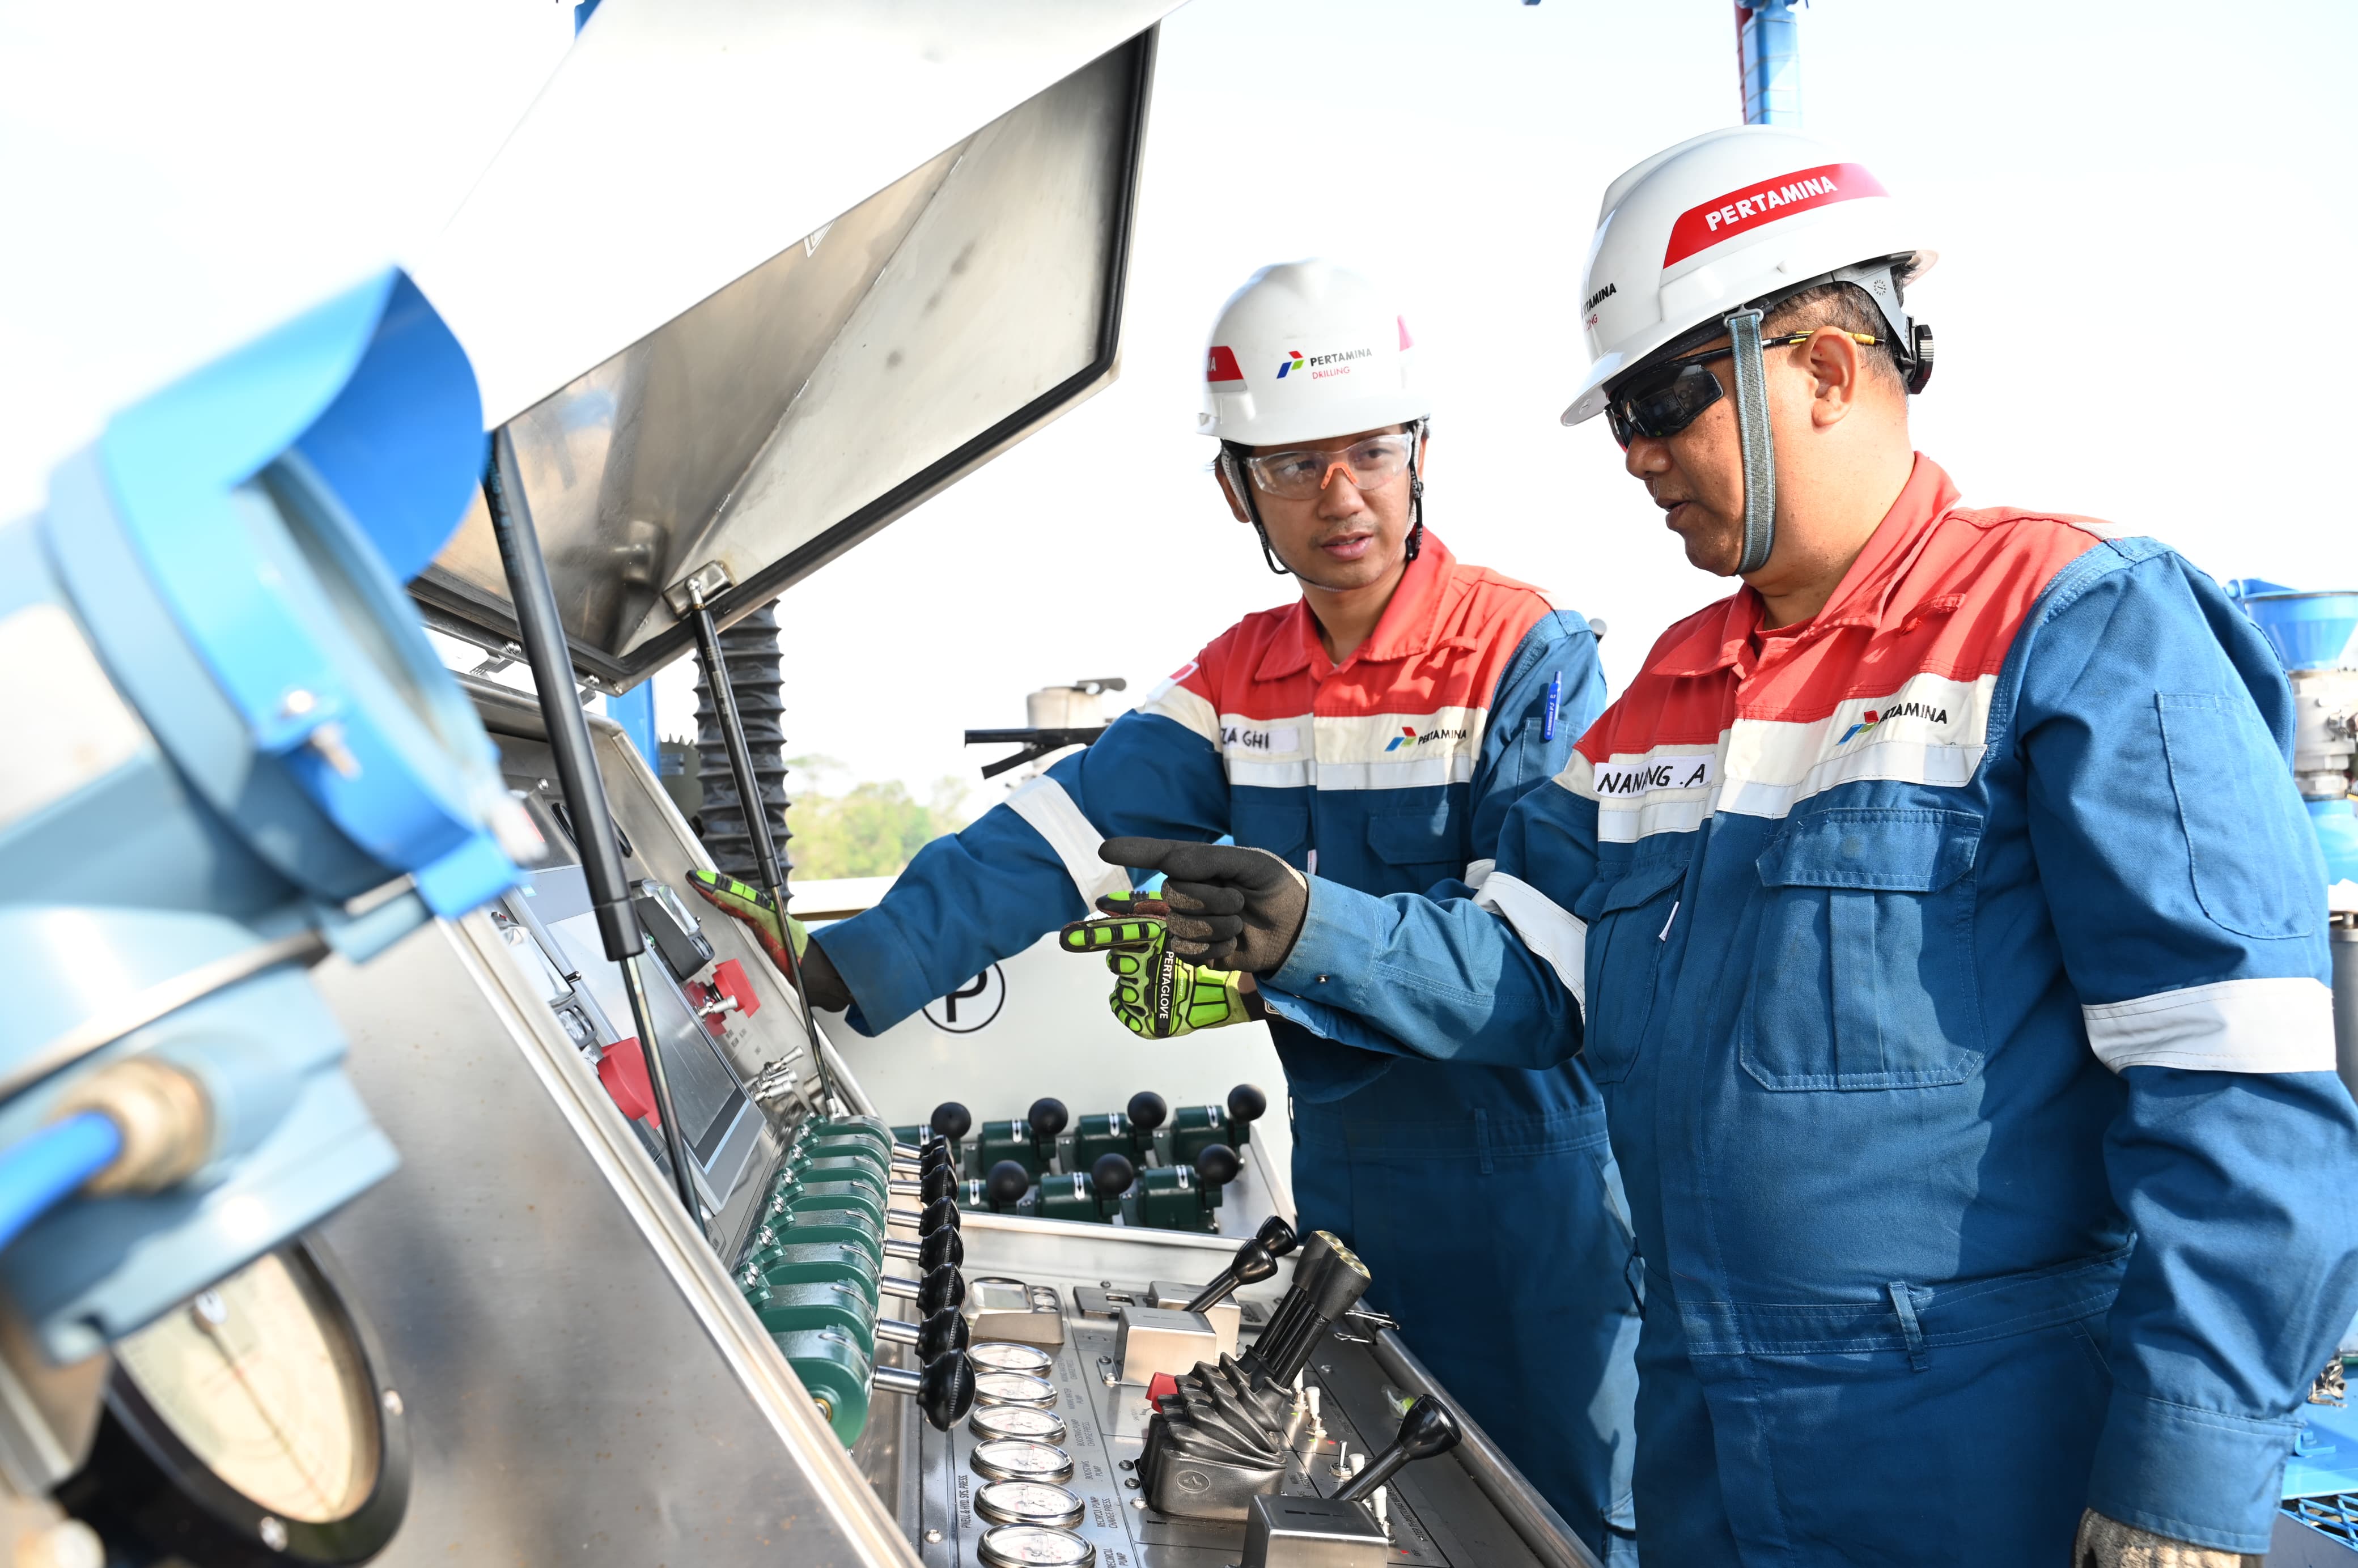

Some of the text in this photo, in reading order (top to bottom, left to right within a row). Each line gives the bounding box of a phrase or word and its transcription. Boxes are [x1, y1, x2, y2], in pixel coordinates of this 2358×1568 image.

[1705, 176, 1838, 231] PERTAMINA
[1583, 283, 1617, 316] RTAMINA
[1310, 348, 1372, 367] PERTAMINA
[1312, 366, 1350, 380] DRILLING
[1418, 729, 1466, 745] PERTAMINA
[1160, 951, 1174, 1019] PERTAGLOVE
[1071, 1418, 1085, 1446] BOOSTING PUMP
[1084, 1433, 1095, 1447] CHARGE
[1082, 1460, 1093, 1480] BOOSTING
[1093, 1465, 1104, 1477] PUMP
[1090, 1496, 1101, 1508] PUMP
[1105, 1512, 1118, 1528] CHARGE
[1117, 1552, 1129, 1567] PUMP
